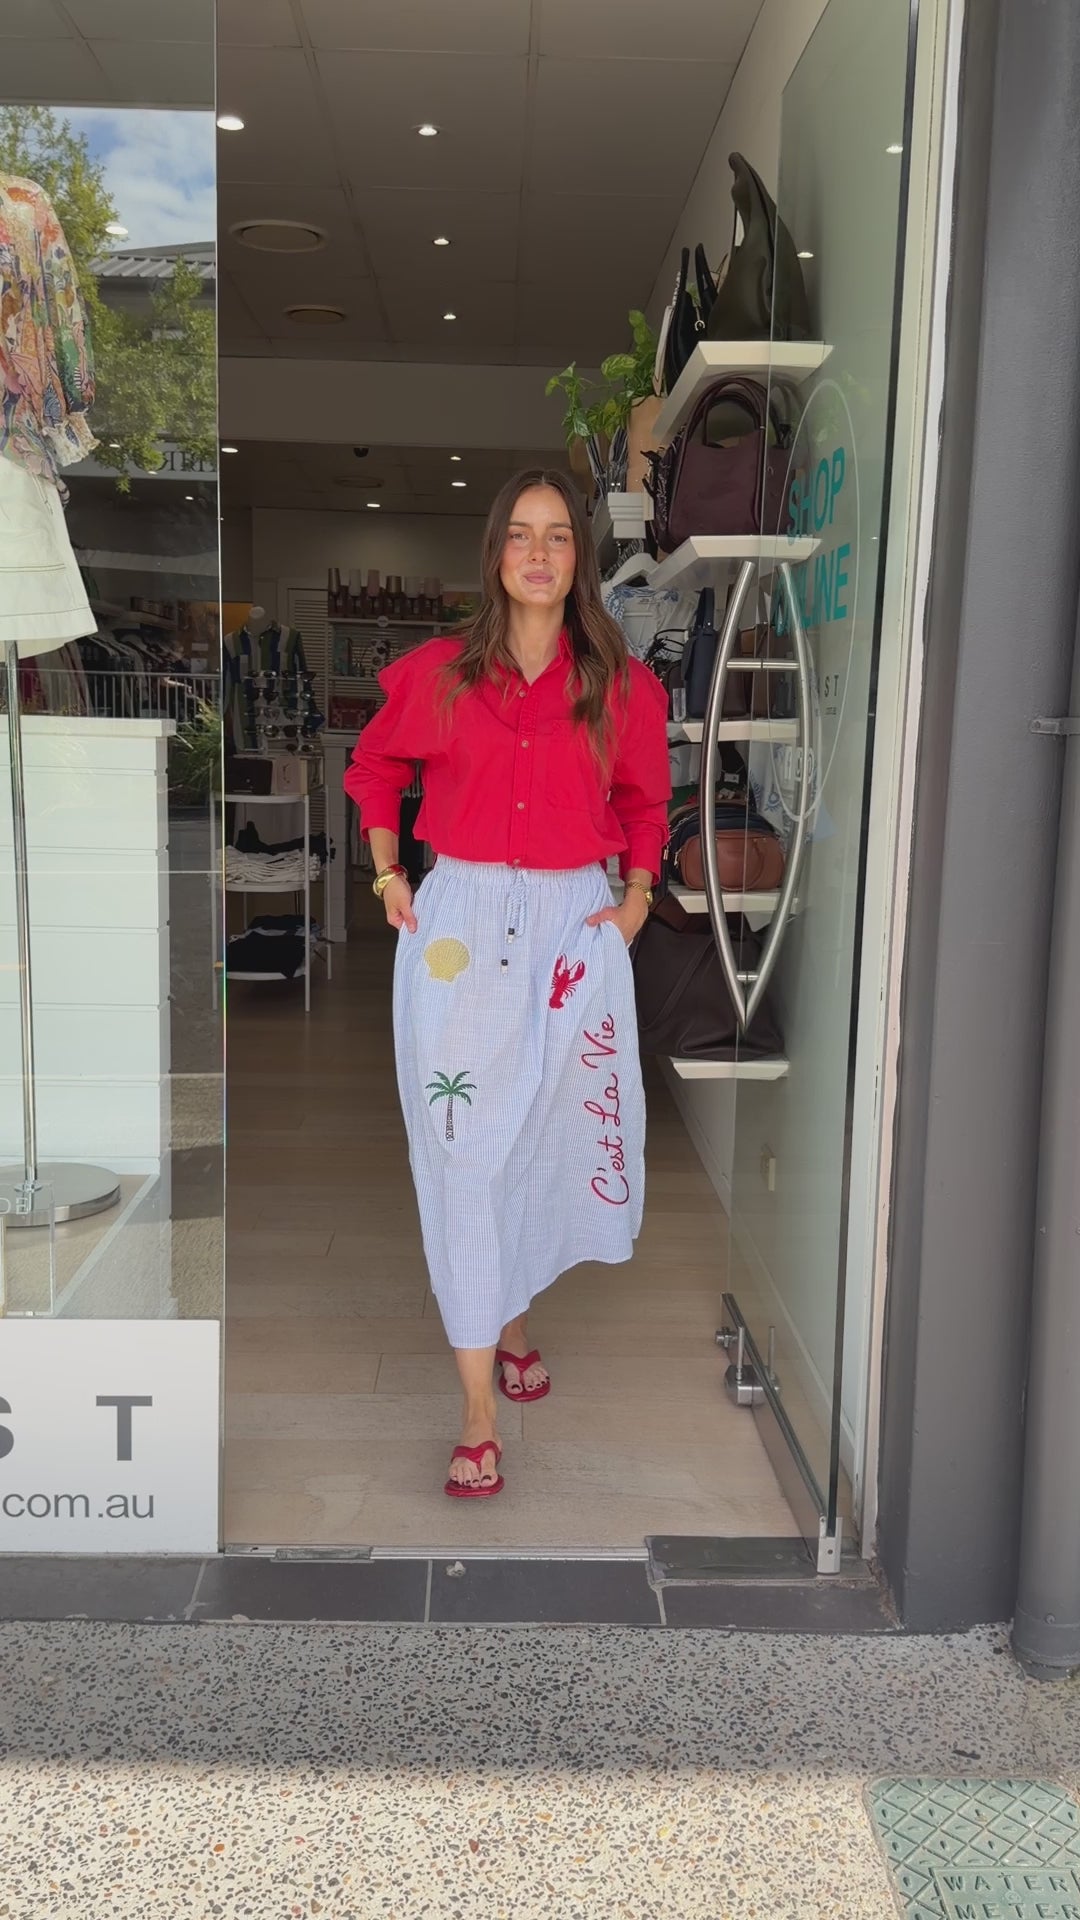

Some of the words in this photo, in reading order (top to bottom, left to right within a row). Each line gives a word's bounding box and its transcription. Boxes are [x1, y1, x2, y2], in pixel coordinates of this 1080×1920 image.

[787, 446, 845, 546] SHOP
[581, 1012, 617, 1069] Vie
[583, 1072, 621, 1127] La
[590, 1135, 630, 1205] C'est
[943, 1874, 1069, 1893] WATER
[954, 1902, 1080, 1919] METER
